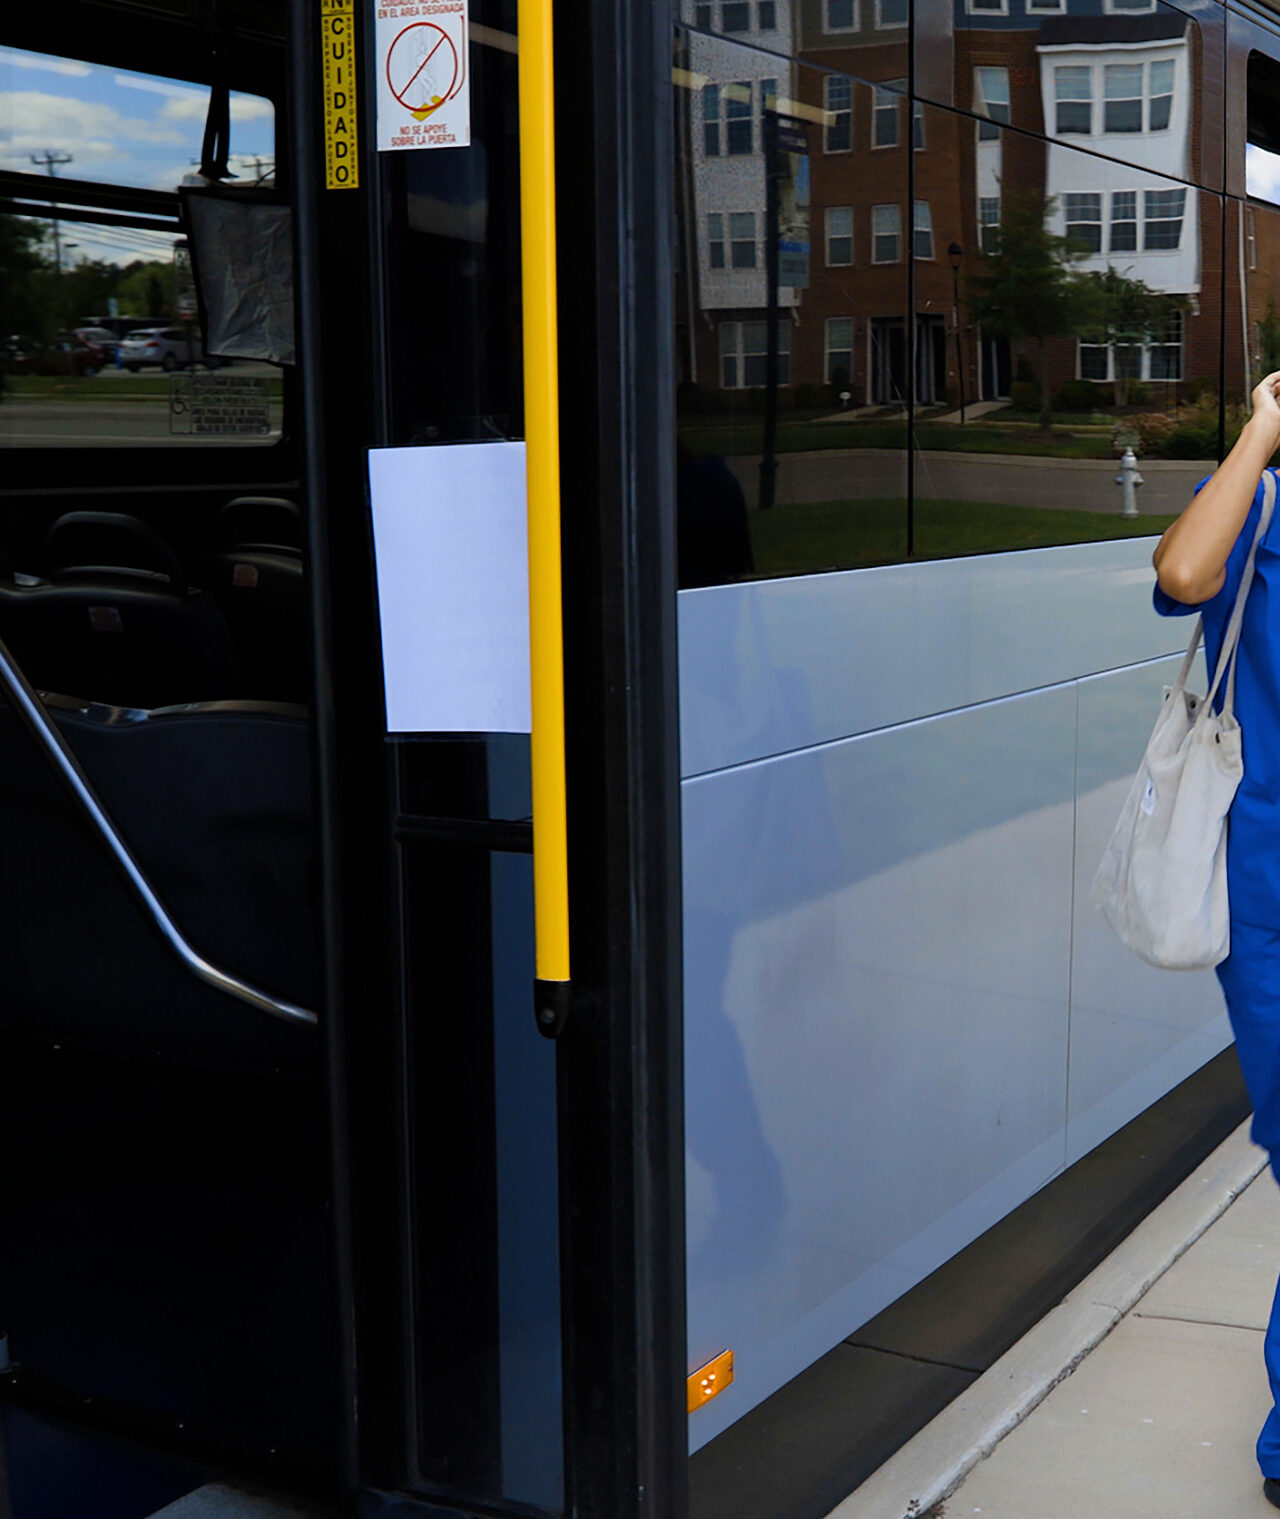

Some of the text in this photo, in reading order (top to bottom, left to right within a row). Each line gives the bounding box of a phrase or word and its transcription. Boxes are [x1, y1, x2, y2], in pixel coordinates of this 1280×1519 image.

[378, 9, 388, 19] EN
[390, 8, 398, 18] EL
[422, 3, 464, 15] DESIGNADA
[331, 17, 350, 183] CUIDADO
[400, 123, 447, 136] NO SE APOYE
[391, 133, 456, 147] SOBRE LA PUERTA
